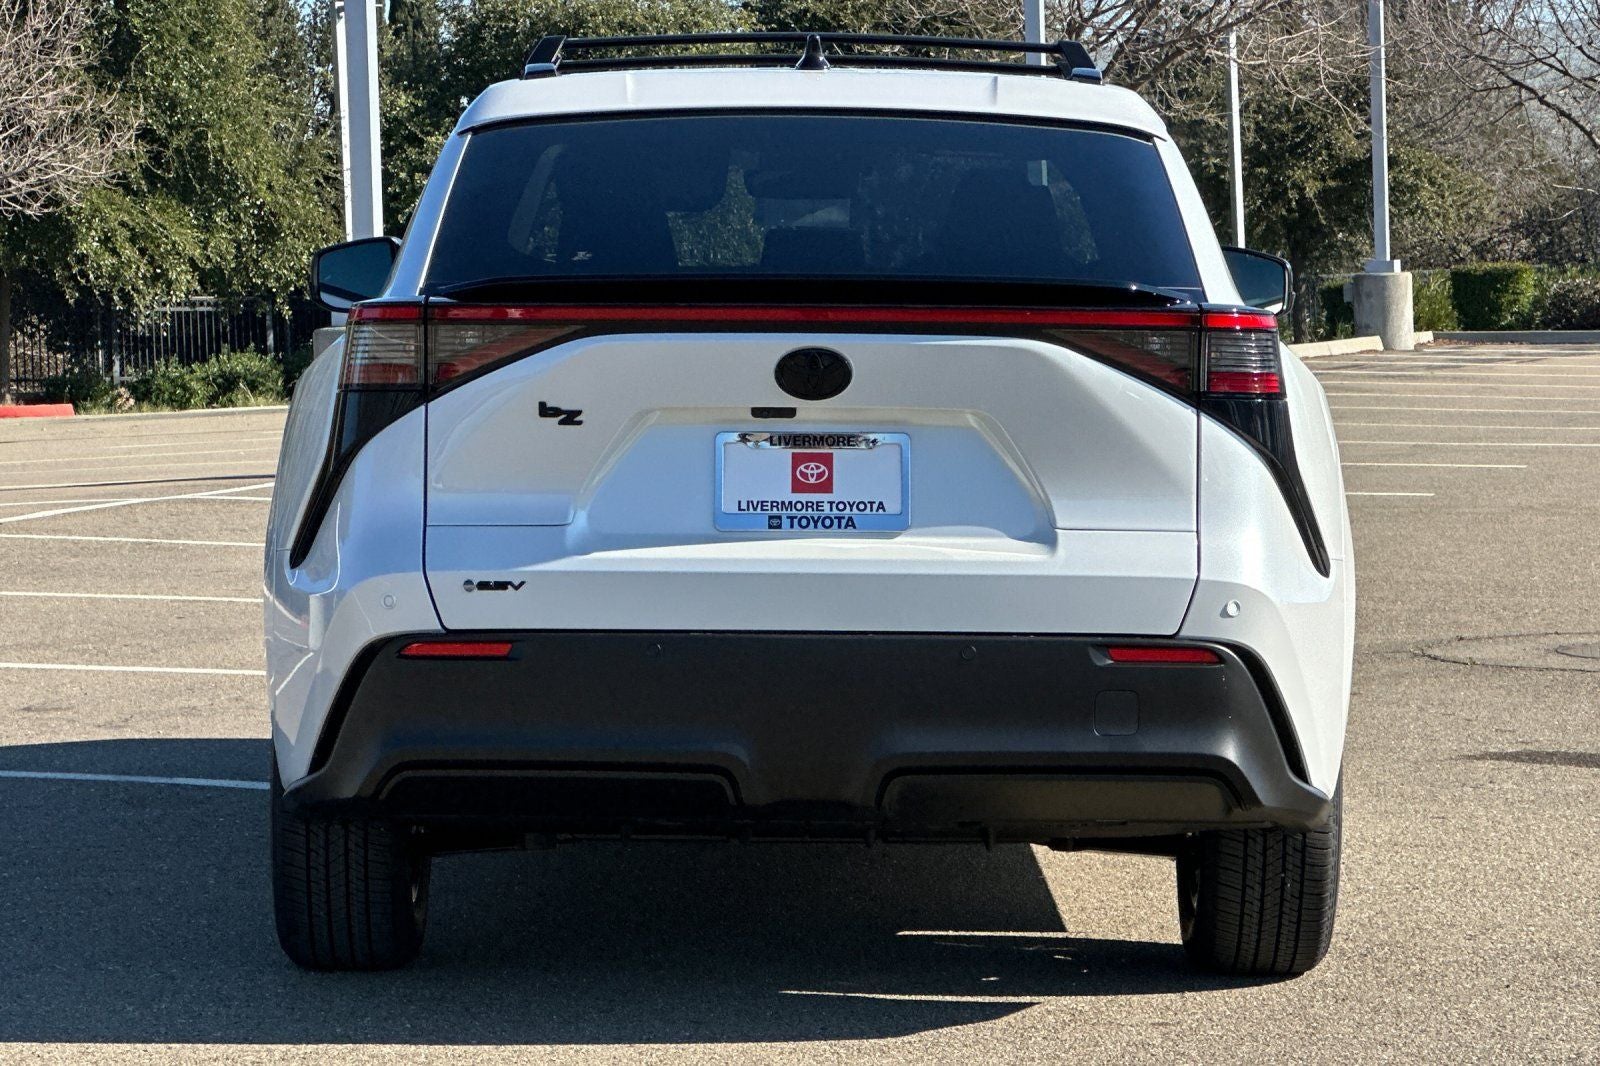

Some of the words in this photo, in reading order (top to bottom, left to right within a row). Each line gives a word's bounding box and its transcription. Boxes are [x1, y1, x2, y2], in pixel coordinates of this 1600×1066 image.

[769, 434, 857, 447] LIVERMORE
[737, 501, 824, 512] LIVERMORE
[828, 501, 886, 512] TOYOTA
[787, 516, 857, 529] TOYOTA
